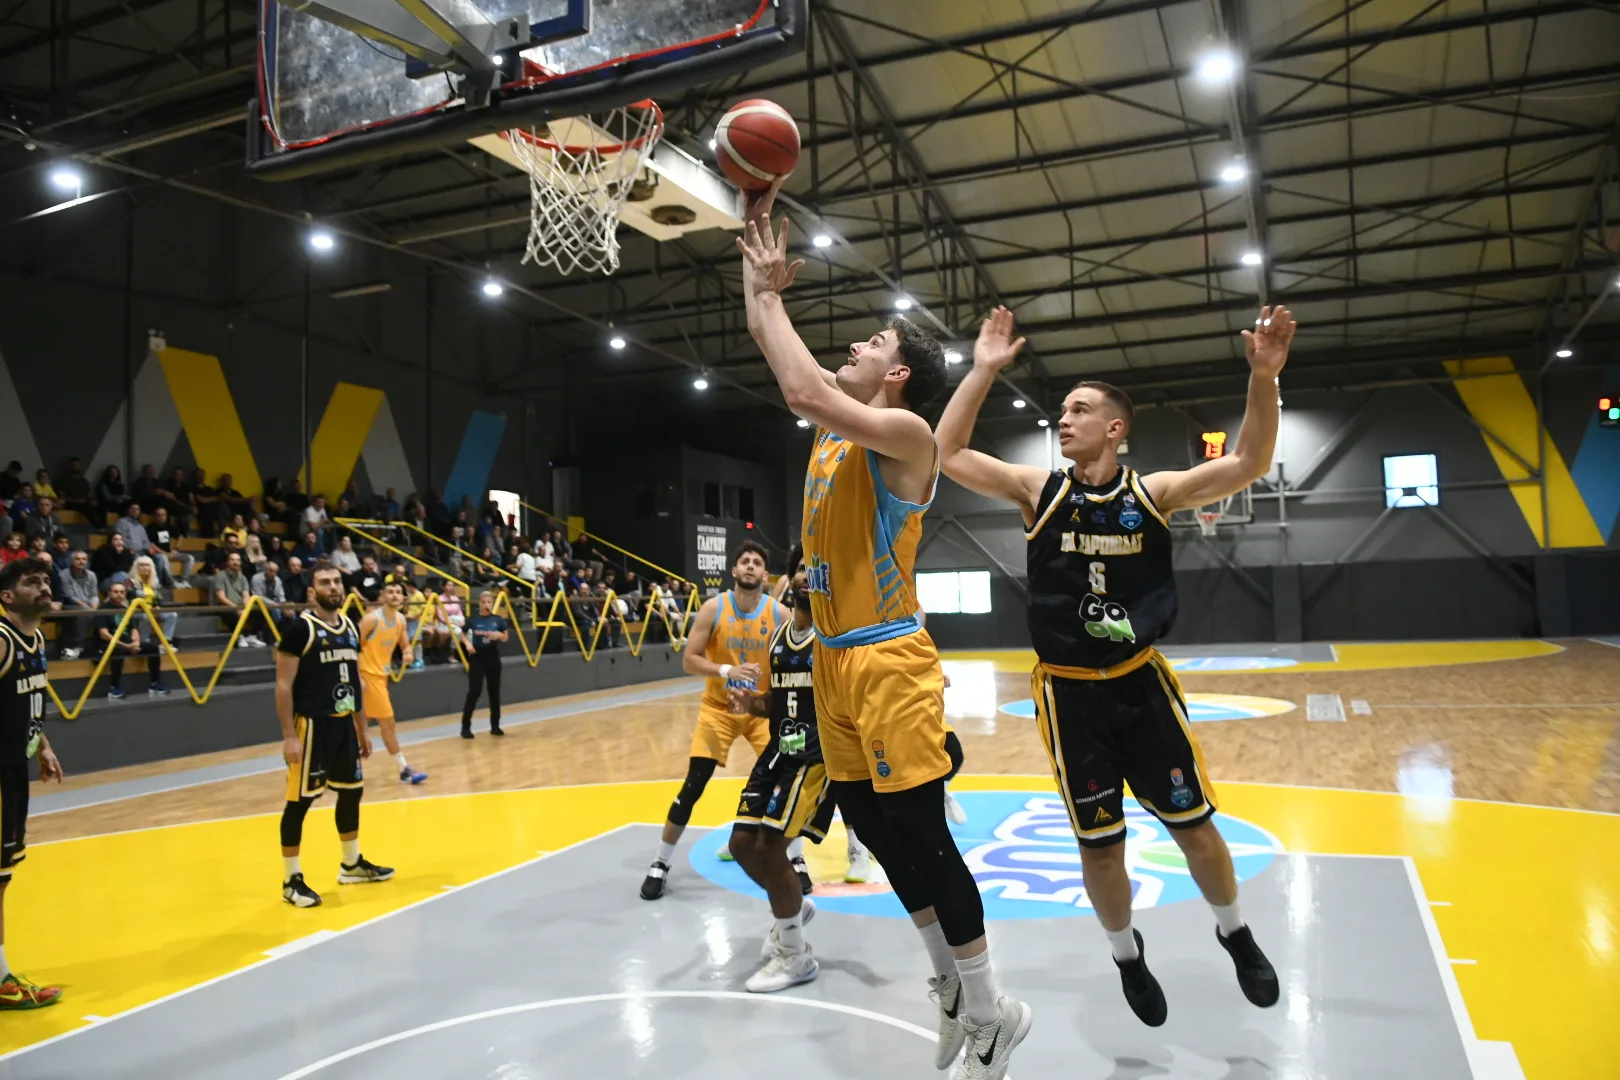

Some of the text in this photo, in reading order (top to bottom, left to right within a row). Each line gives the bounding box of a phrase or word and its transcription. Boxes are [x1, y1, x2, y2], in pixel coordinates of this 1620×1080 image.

[1088, 562, 1107, 594] 6
[339, 663, 350, 683] 9
[30, 692, 43, 719] 10
[787, 691, 798, 718] 5
